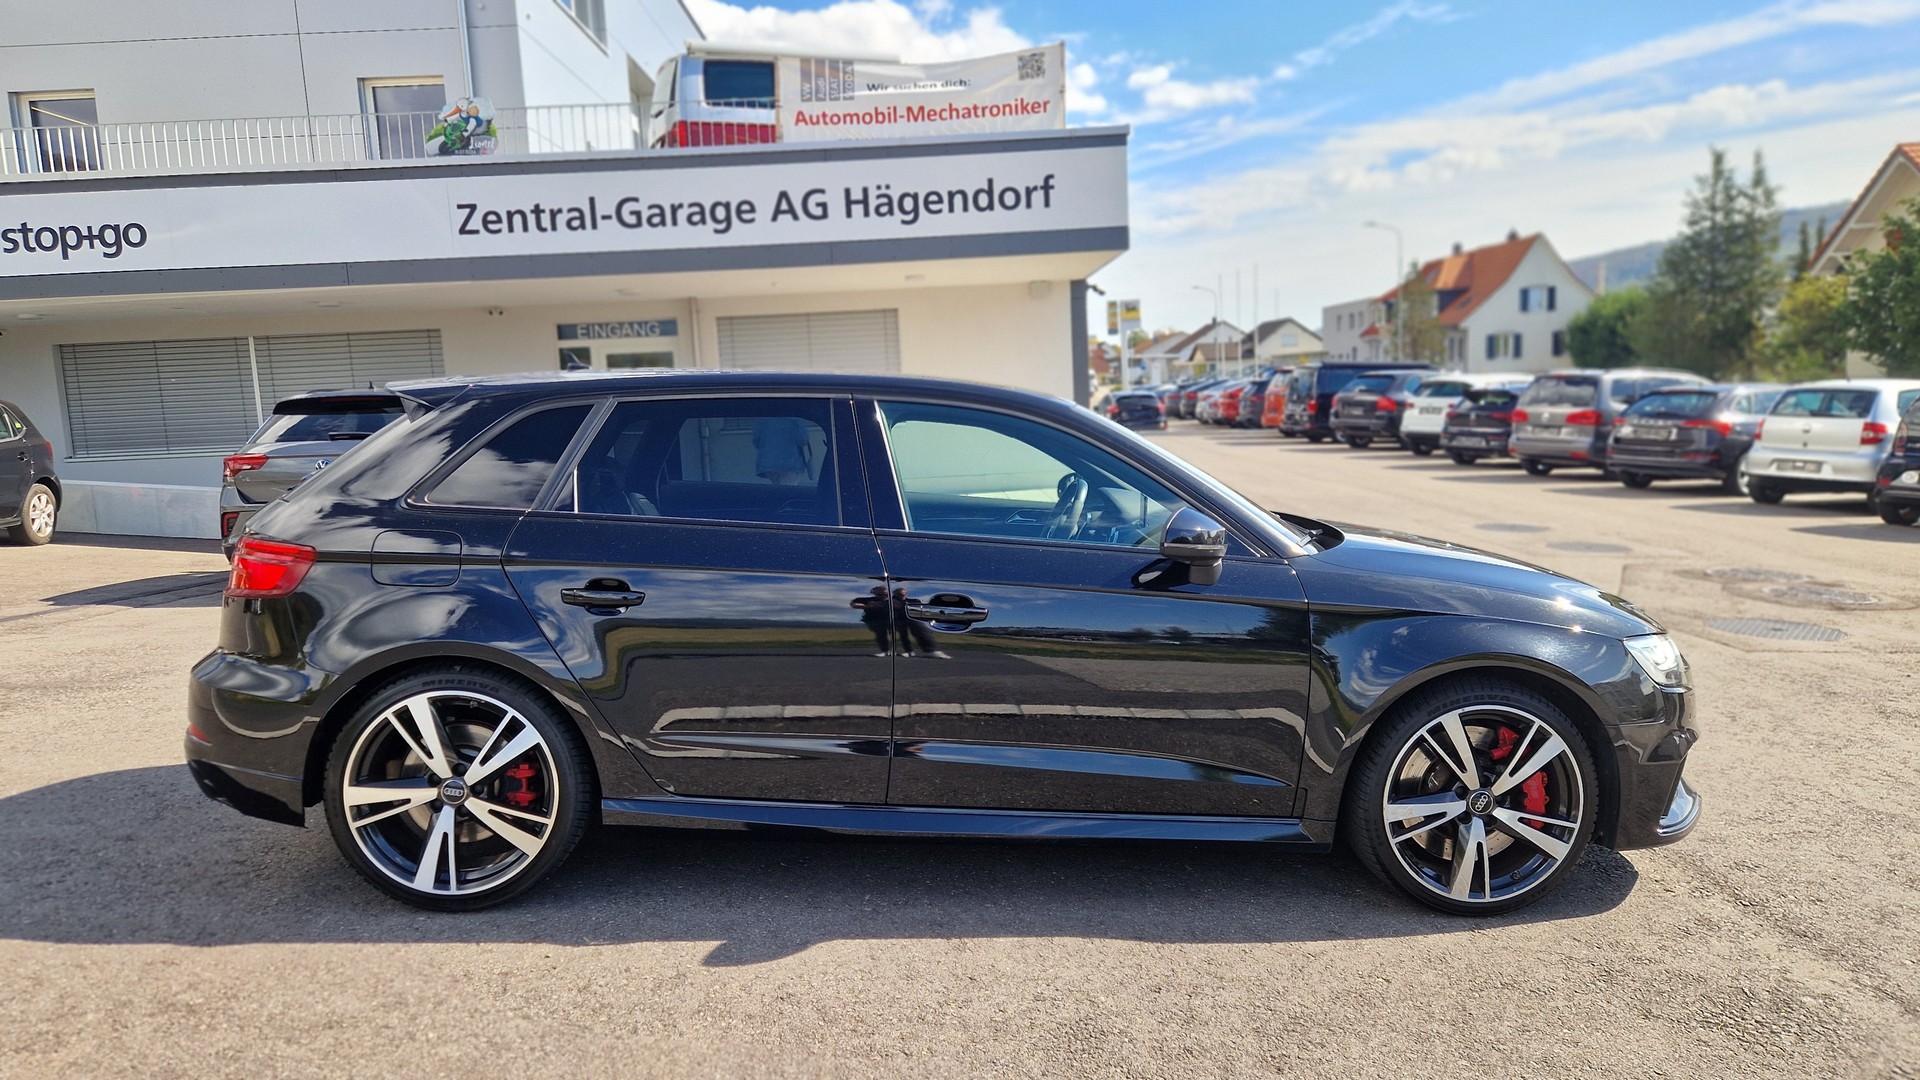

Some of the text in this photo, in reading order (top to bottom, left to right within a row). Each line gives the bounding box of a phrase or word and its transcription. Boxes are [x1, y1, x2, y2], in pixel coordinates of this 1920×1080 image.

[816, 77, 825, 99] Audi
[830, 78, 840, 99] SEAT
[866, 78, 971, 92] Wir suchen dich:
[794, 98, 1051, 127] Automobil-Mechatroniker
[456, 174, 1055, 235] Zentral-Garage AG Hägendorf
[1, 222, 148, 260] stop+go
[576, 322, 660, 339] EINGANG
[421, 680, 500, 694] MINERVA
